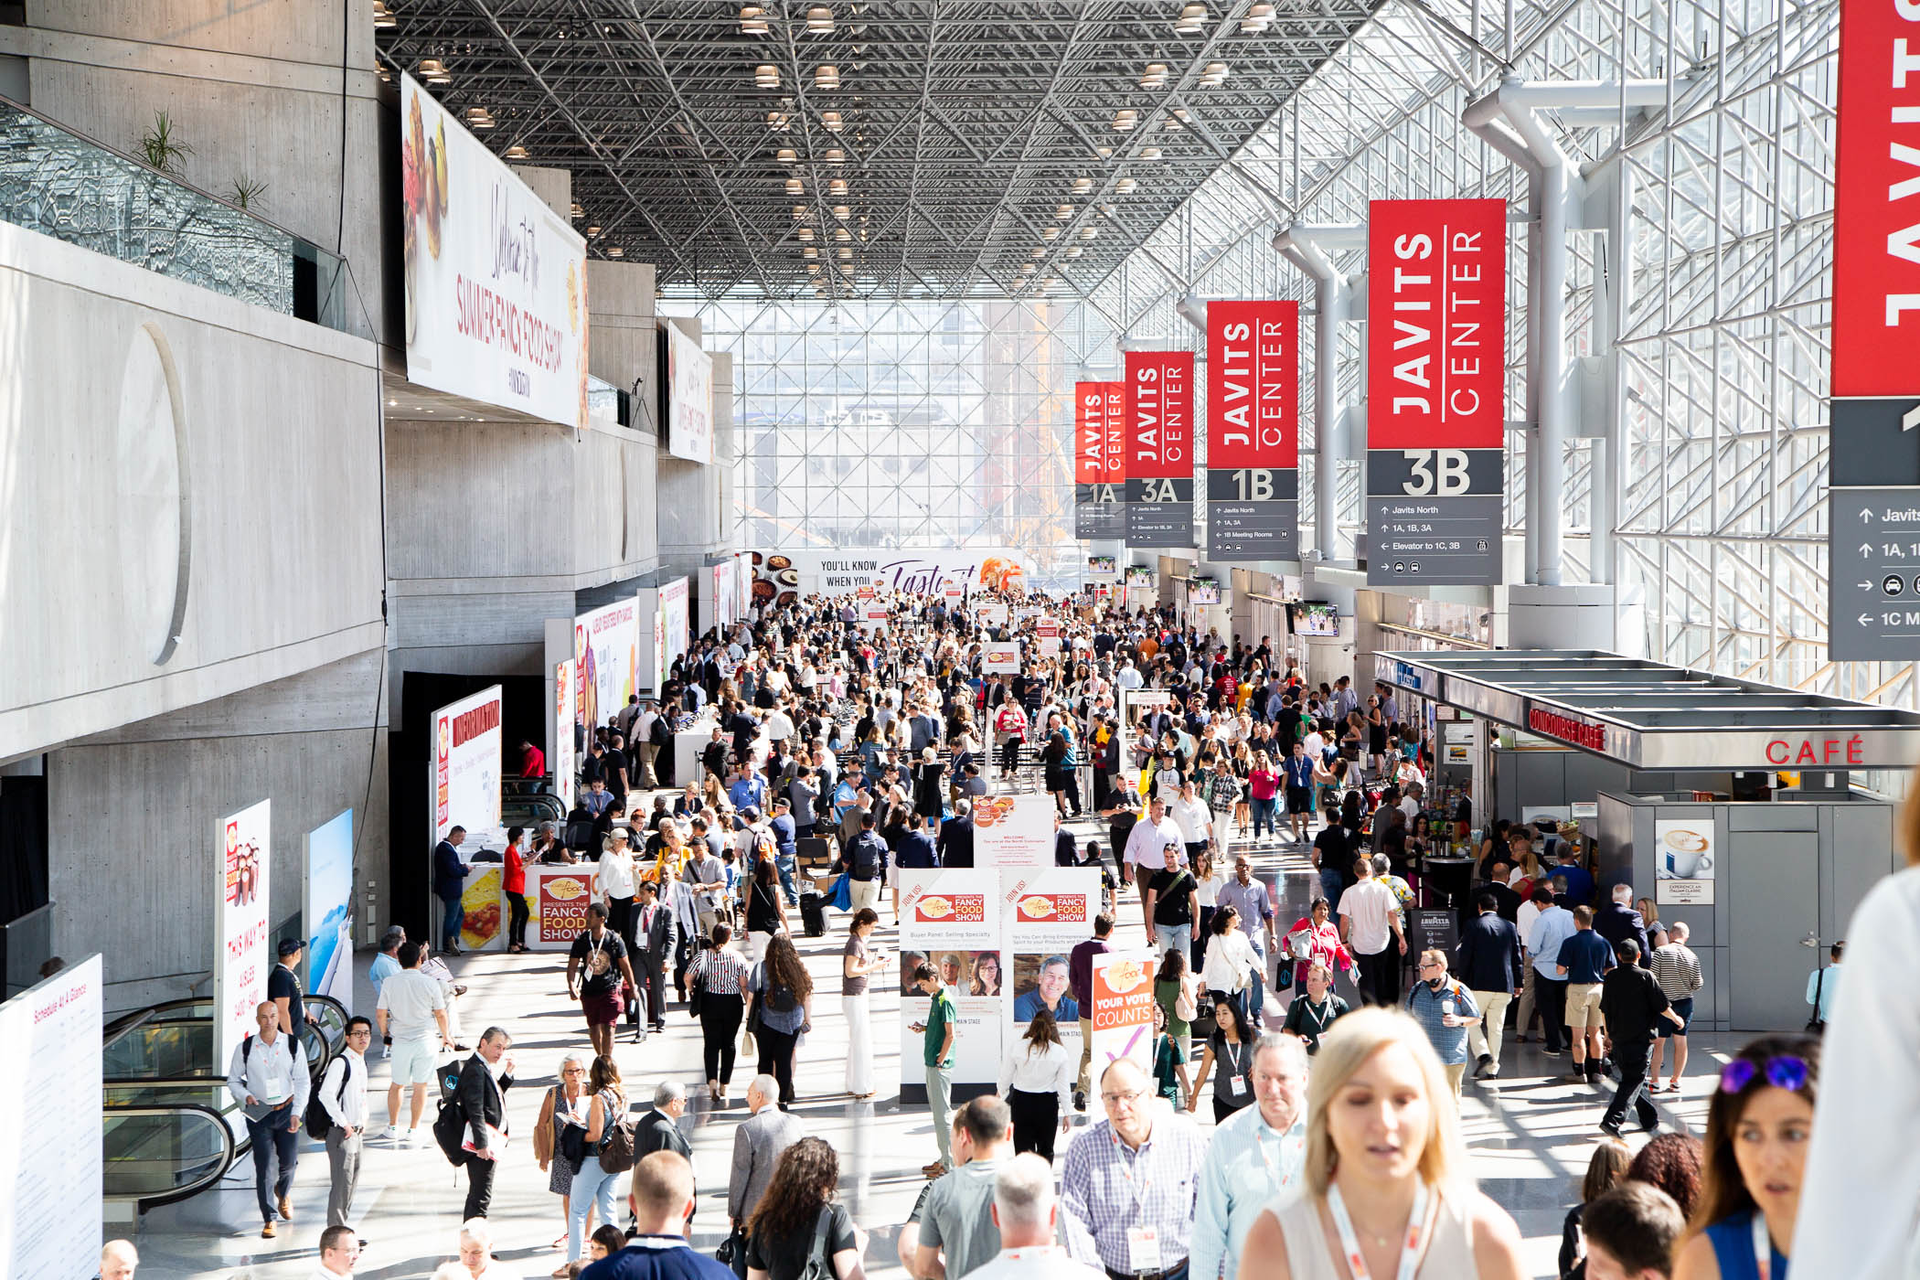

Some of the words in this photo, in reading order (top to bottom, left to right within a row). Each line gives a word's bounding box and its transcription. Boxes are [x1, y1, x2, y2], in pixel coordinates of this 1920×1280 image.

[456, 273, 495, 344] SUMMER
[496, 295, 521, 357] FANCY
[523, 311, 544, 367] FOOD
[544, 323, 563, 374] SHOW
[1393, 233, 1433, 414] JAVITS
[1450, 231, 1482, 416] CENTER
[1223, 322, 1250, 446] JAVITS
[1262, 321, 1283, 447] CENTER
[1137, 368, 1157, 461] JAVITS
[1166, 367, 1182, 462] CENTER
[1084, 394, 1101, 470] JAVITS
[1108, 394, 1121, 471] CENTER
[1402, 450, 1471, 495] 3B
[1088, 483, 1117, 503] 1A
[1141, 479, 1178, 503] 3A
[1231, 469, 1274, 500] 1B
[1392, 506, 1414, 515] Javits
[1416, 506, 1439, 515] North
[1233, 531, 1253, 539] Meeting
[1392, 524, 1406, 533] 1A,
[1407, 524, 1419, 533] 1B,
[1420, 524, 1433, 532] 3A
[1392, 542, 1424, 550] Elevator
[1434, 542, 1446, 551] 1C,
[1447, 542, 1461, 550] 3B
[1881, 544, 1905, 559] 1A,
[1910, 544, 1920, 557] 1
[821, 560, 849, 572] YOU'LL
[852, 560, 877, 571] KNOW
[880, 559, 944, 597] Taste
[826, 576, 852, 587] WHEN
[1881, 613, 1902, 626] 1C
[453, 699, 500, 748] INFORMATION
[1529, 708, 1578, 744] CONCOURSE
[1766, 734, 1864, 765] CAFÉ
[902, 893, 915, 907] JOIN
[955, 898, 983, 906] FANCY
[1005, 889, 1018, 903] JOIN
[1057, 898, 1085, 906] FANCY
[543, 907, 588, 917] FANCY
[955, 906, 983, 914] FOOD
[955, 914, 982, 922] SHOW
[1057, 906, 1085, 914] FOOD
[1057, 914, 1084, 922] SHOW
[543, 917, 587, 929] FOOD
[227, 933, 243, 964] THIS
[243, 924, 257, 956] WAY
[257, 918, 266, 946] TO
[910, 931, 926, 939] Buyer
[1096, 996, 1124, 1010] YOUR
[1124, 992, 1151, 1004] VOTE
[34, 1002, 58, 1024] Schedule
[1096, 1005, 1151, 1027] COUNTS
